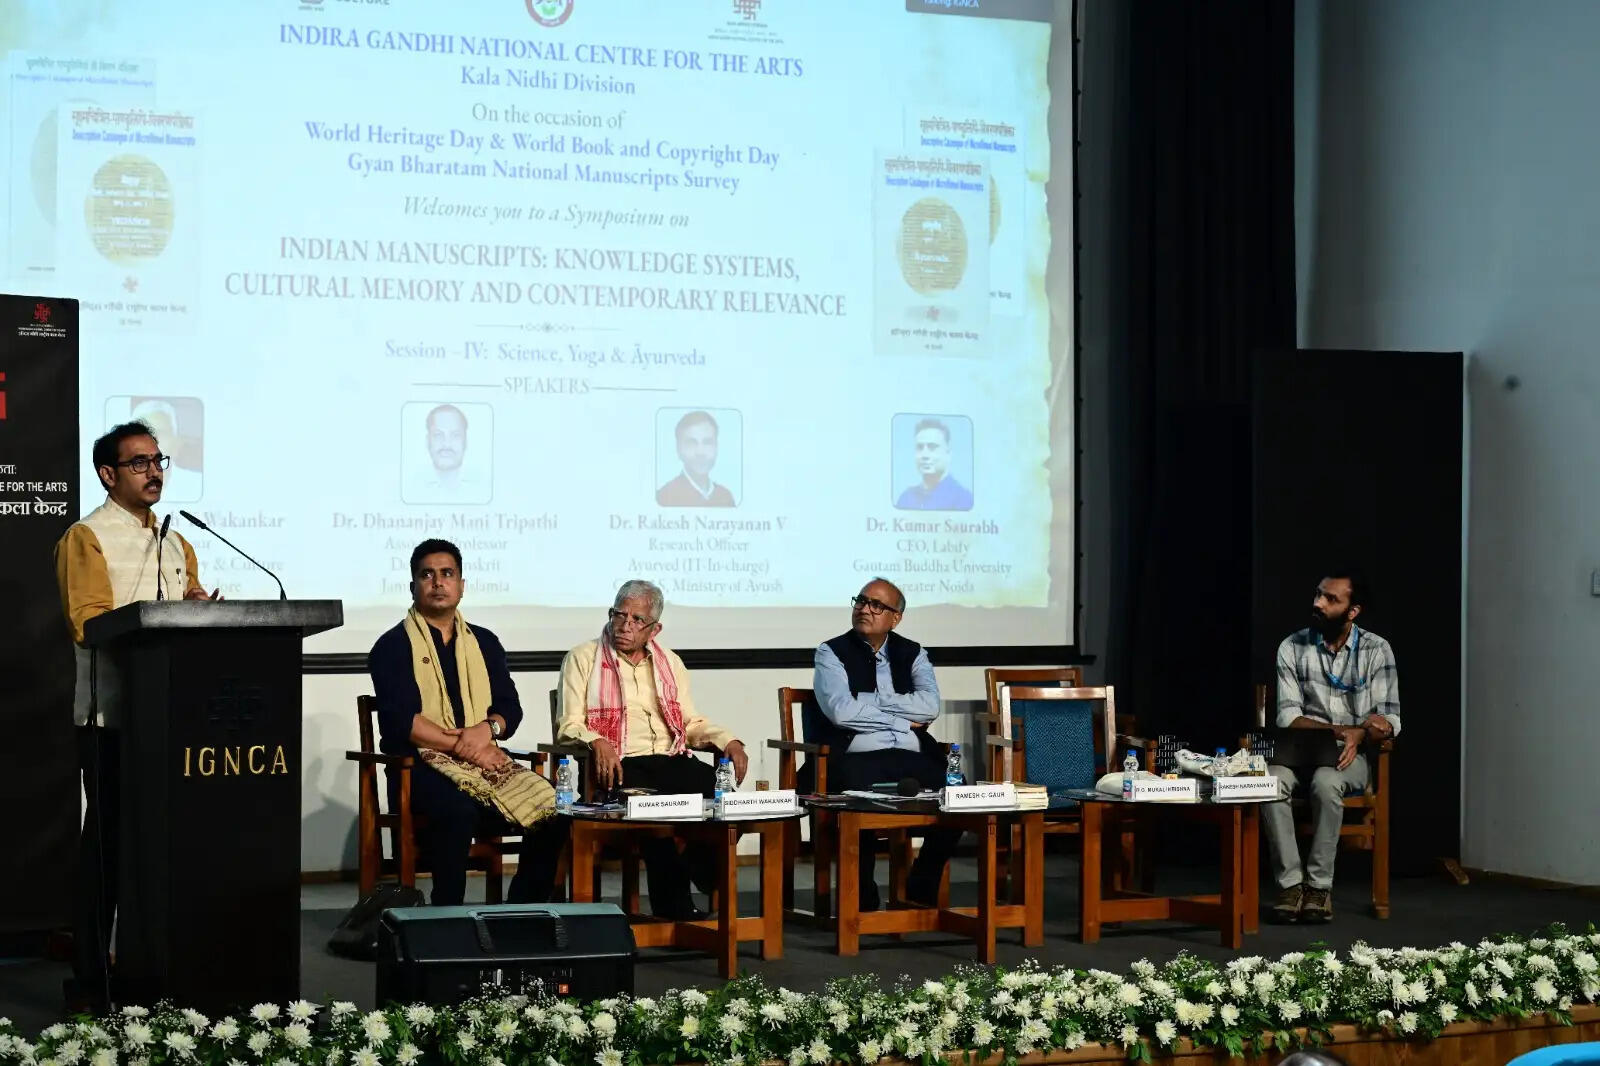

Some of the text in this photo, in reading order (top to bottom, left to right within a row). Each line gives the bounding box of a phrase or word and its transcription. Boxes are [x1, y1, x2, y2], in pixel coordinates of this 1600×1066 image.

[280, 23, 804, 77] INDIRA GANDHI NATIONAL CENTRE FOR THE ARTS
[461, 65, 636, 95] Kala Nidhi Division
[472, 103, 627, 129] On the occasion of
[305, 121, 780, 171] World Heritage Day & World Book and Copyright Day
[348, 152, 740, 196] Gyan Bharatam National Manuscripts Survey
[404, 196, 690, 229] Welcomes you to a Symposium on
[280, 235, 800, 282] INDIAN MANUSCRIPTS: KNOWLEDGE SYSTEMS,
[225, 272, 847, 317] CULTURAL MEMORY AND CONTEMPORARY RELEVANCE
[385, 340, 446, 359] Session
[498, 342, 563, 364] Science,
[567, 344, 605, 368] Yoga
[611, 347, 627, 364] &
[504, 376, 590, 395] SPEAKERS
[6, 481, 25, 492] FOR
[26, 481, 44, 492] THE
[45, 481, 68, 493] ARTS
[332, 511, 559, 533] Dr. Dhananjay Mani Tripathi
[609, 514, 633, 530] Dr.
[638, 514, 690, 530] Rakesh
[695, 515, 771, 535] Narayanan
[866, 517, 1000, 536] Dr. Kumar Saurabh
[648, 536, 751, 552] Research Officer
[461, 555, 501, 572] nskrit
[853, 559, 1013, 579] Gautam Buddha University
[901, 578, 976, 594] reater Noida
[184, 745, 288, 777] IGNCA
[955, 791, 980, 800] RAMESH
[988, 791, 1005, 799] GAUR
